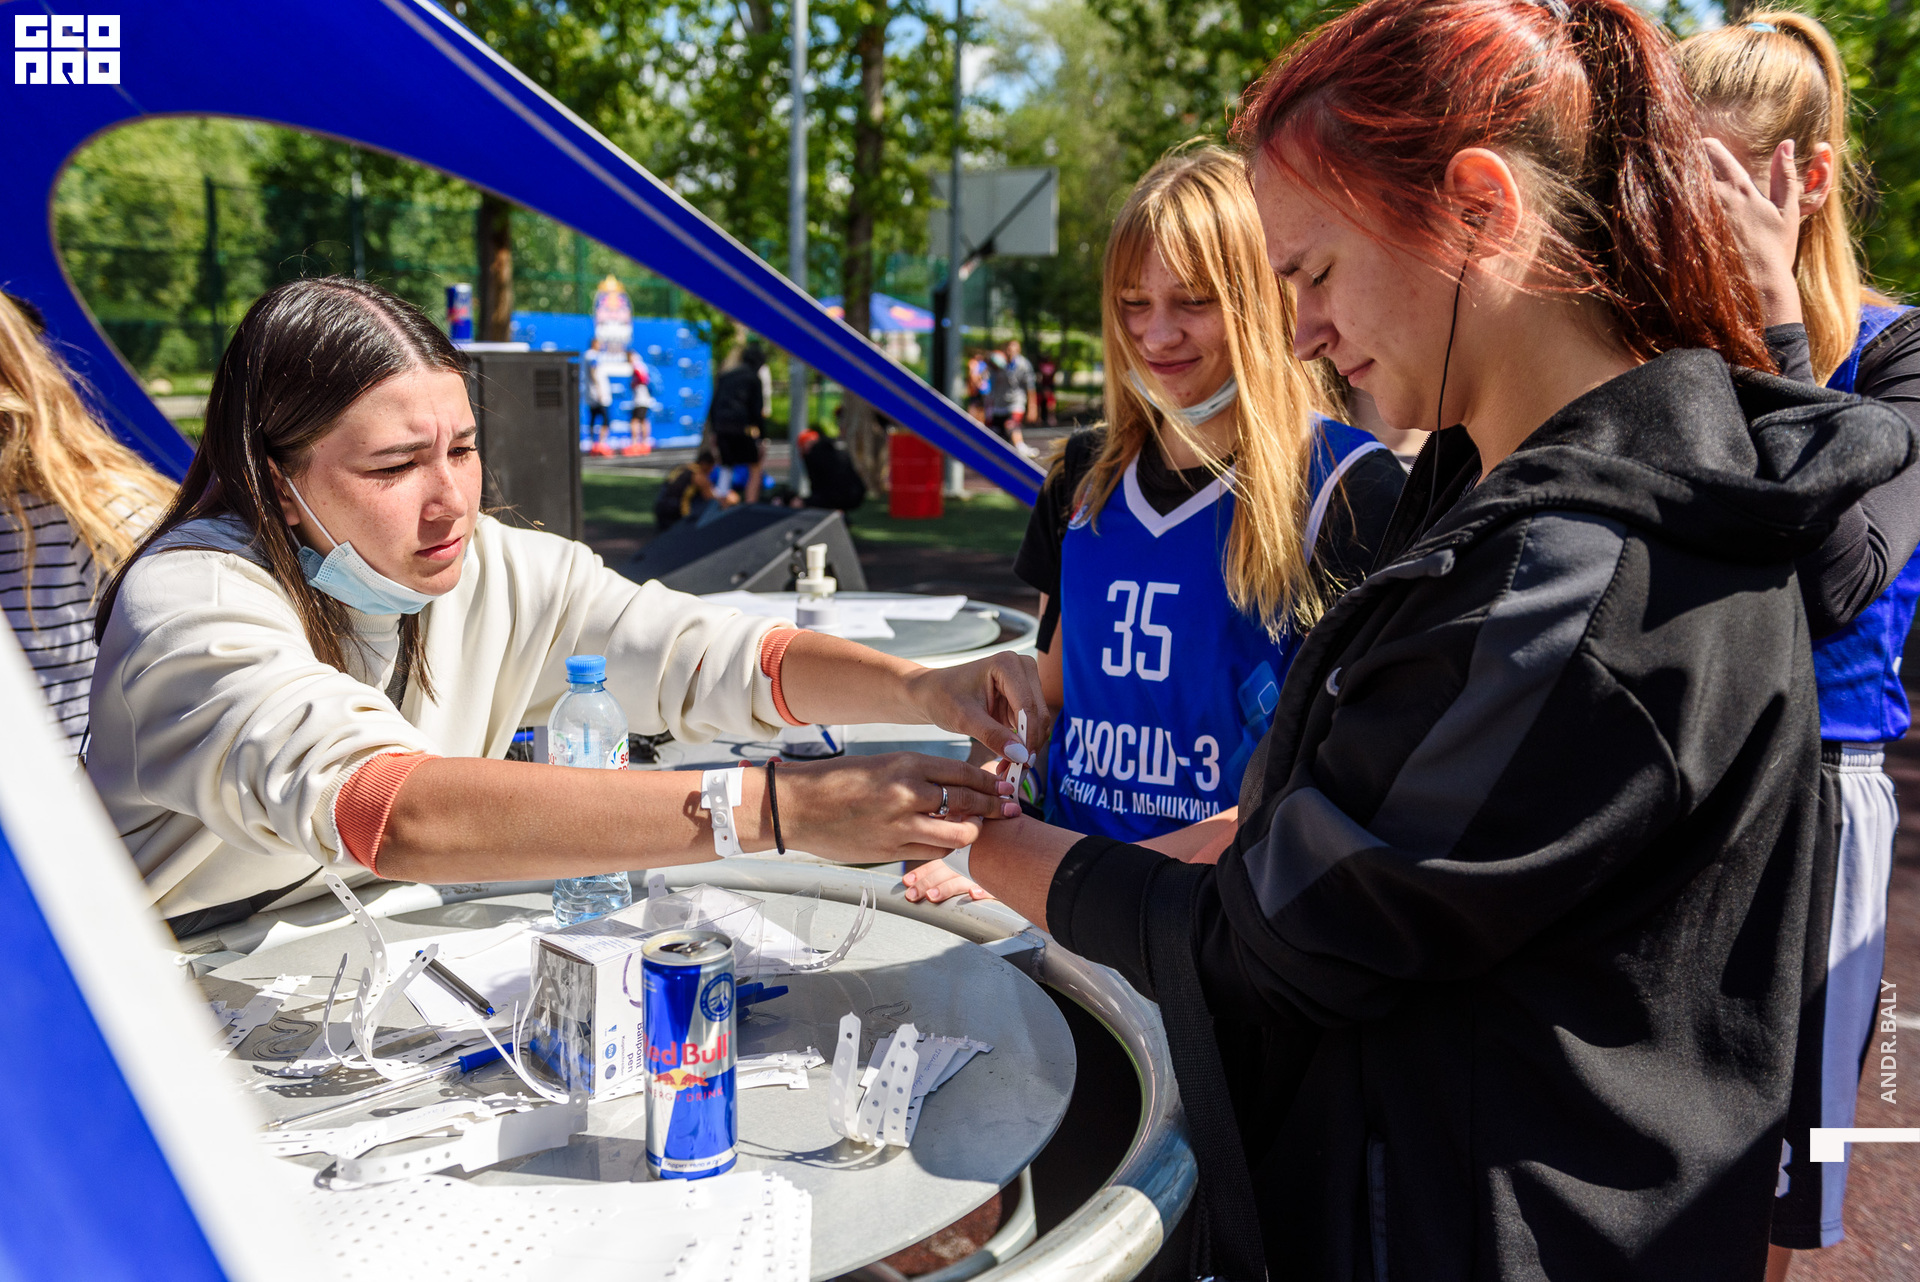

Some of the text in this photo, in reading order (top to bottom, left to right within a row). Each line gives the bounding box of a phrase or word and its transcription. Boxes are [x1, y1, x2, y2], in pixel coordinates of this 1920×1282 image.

[1101, 579, 1181, 682] 35
[1065, 716, 1220, 792] ДЮСШ-3
[1059, 773, 1097, 805] ИЕНИ
[1132, 792, 1220, 821] МЫШКИНА
[626, 1052, 634, 1073] pen
[682, 1033, 727, 1066] Bull
[646, 1085, 723, 1103] NERGY DRINK
